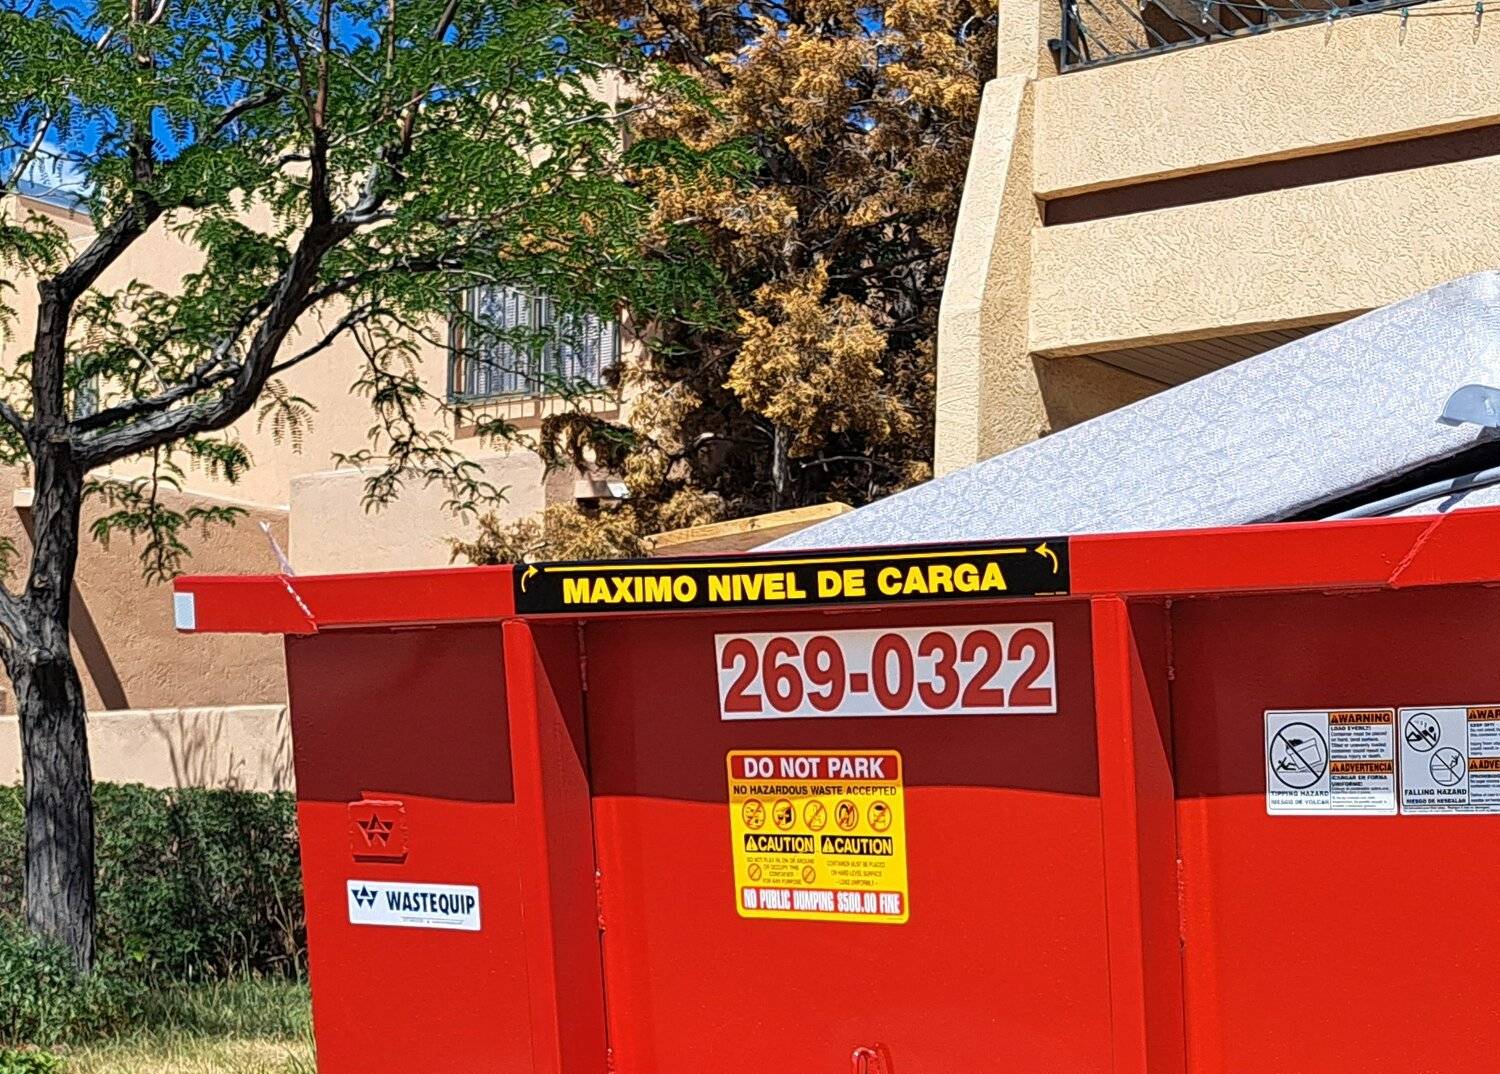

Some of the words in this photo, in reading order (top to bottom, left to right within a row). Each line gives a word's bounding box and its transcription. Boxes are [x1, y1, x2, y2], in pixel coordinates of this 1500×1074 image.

[563, 576, 697, 604] MAXIMO
[708, 570, 806, 602] NIVEL
[817, 569, 866, 598] DE
[877, 563, 1007, 595] CARGA
[721, 628, 1053, 714] 269-0322
[1338, 713, 1390, 723] WARNING
[744, 757, 774, 778] DO
[780, 757, 820, 778] NOT
[827, 757, 885, 778] PARK
[1340, 763, 1392, 772] ADVERTENCIA
[733, 785, 748, 795] NO
[750, 785, 808, 795] HAZARDOUS
[810, 786, 843, 795] WASTE
[846, 786, 896, 796] ACCEPTED
[758, 836, 814, 852] CAUTION
[835, 838, 892, 854] CAUTION
[386, 891, 475, 915] WASTEQUIP
[743, 888, 757, 908] NO
[759, 889, 790, 910] PUBLIC
[793, 890, 834, 911] DUMPING
[837, 891, 876, 913] $500.00
[879, 893, 900, 914] FINE
